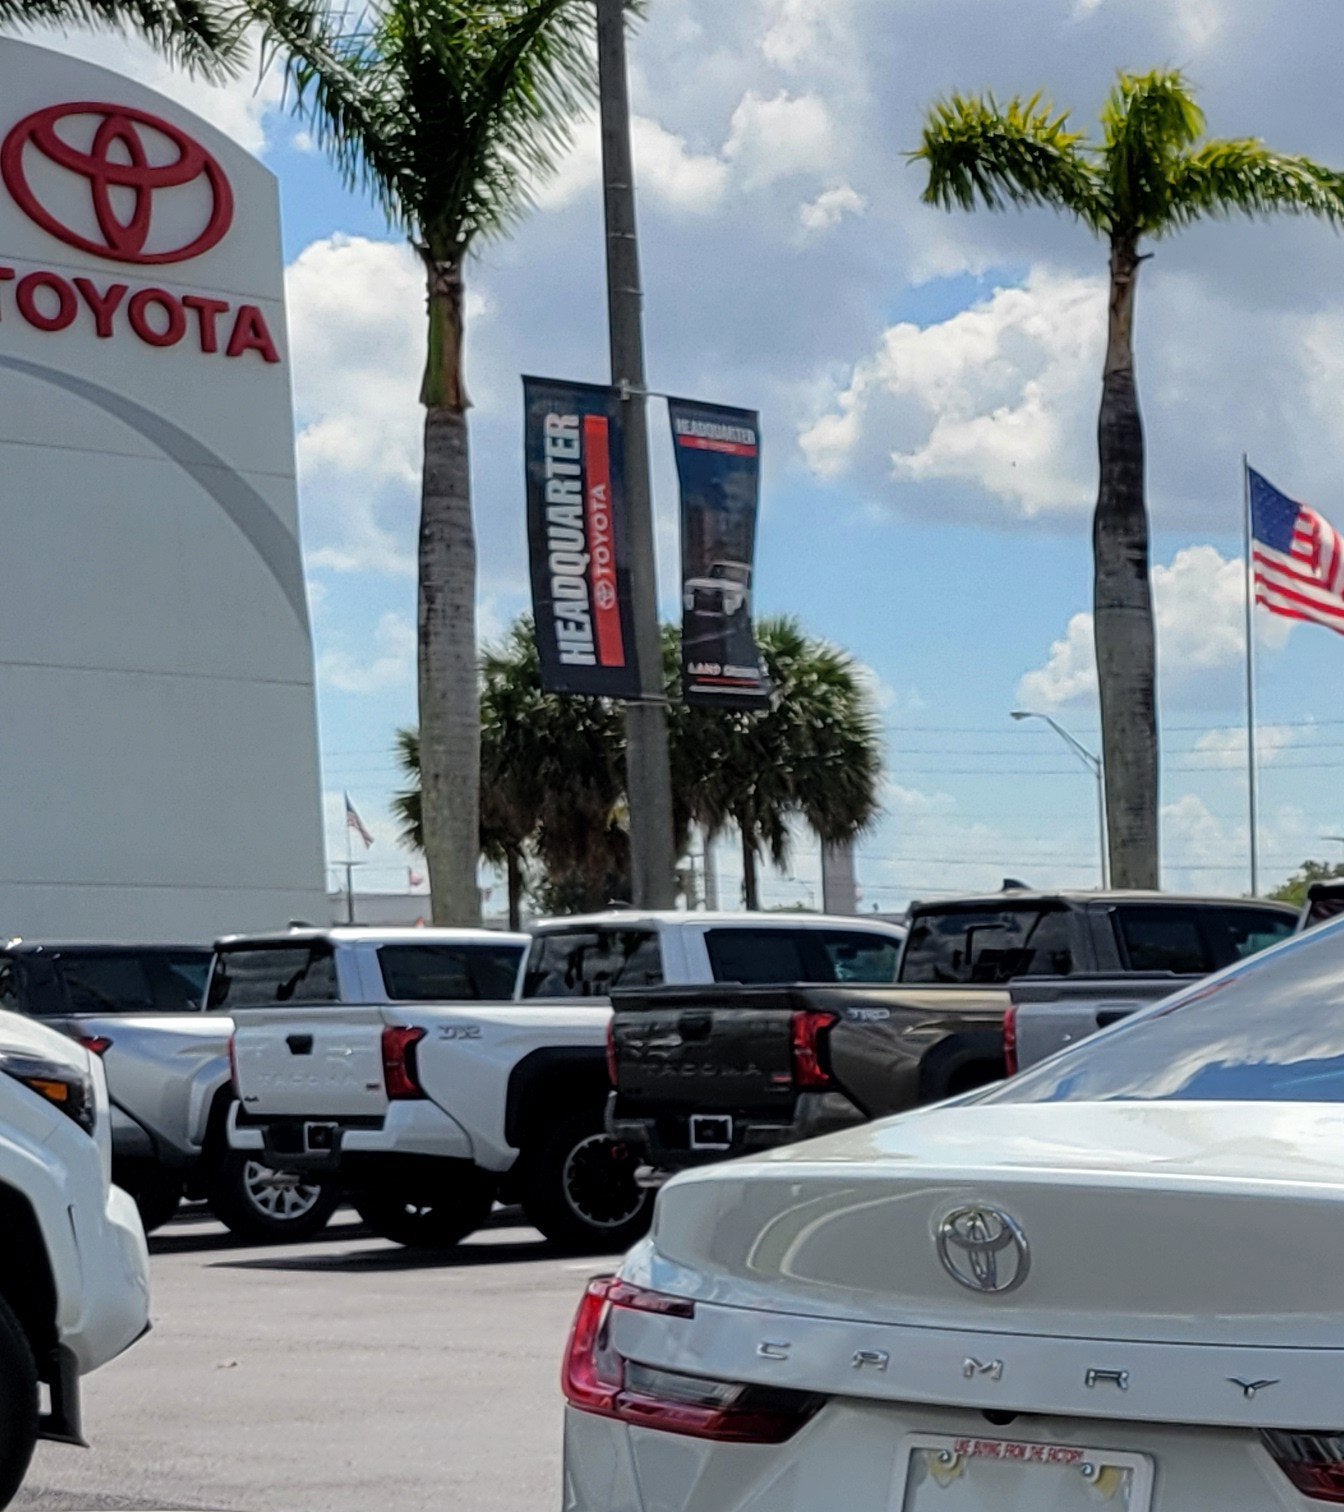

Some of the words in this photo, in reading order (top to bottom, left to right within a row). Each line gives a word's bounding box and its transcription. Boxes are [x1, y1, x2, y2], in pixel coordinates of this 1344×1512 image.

[544, 413, 596, 666] HEADQUARTER
[590, 484, 611, 577] TOYOTA
[847, 1007, 890, 1020] TRD
[756, 1341, 1281, 1399] CAMRY
[954, 1439, 970, 1456] LIKE
[974, 1441, 1001, 1458] BUYING
[1005, 1443, 1027, 1460] FROM
[1031, 1446, 1045, 1460] THE
[1048, 1447, 1084, 1465] FACTORY
